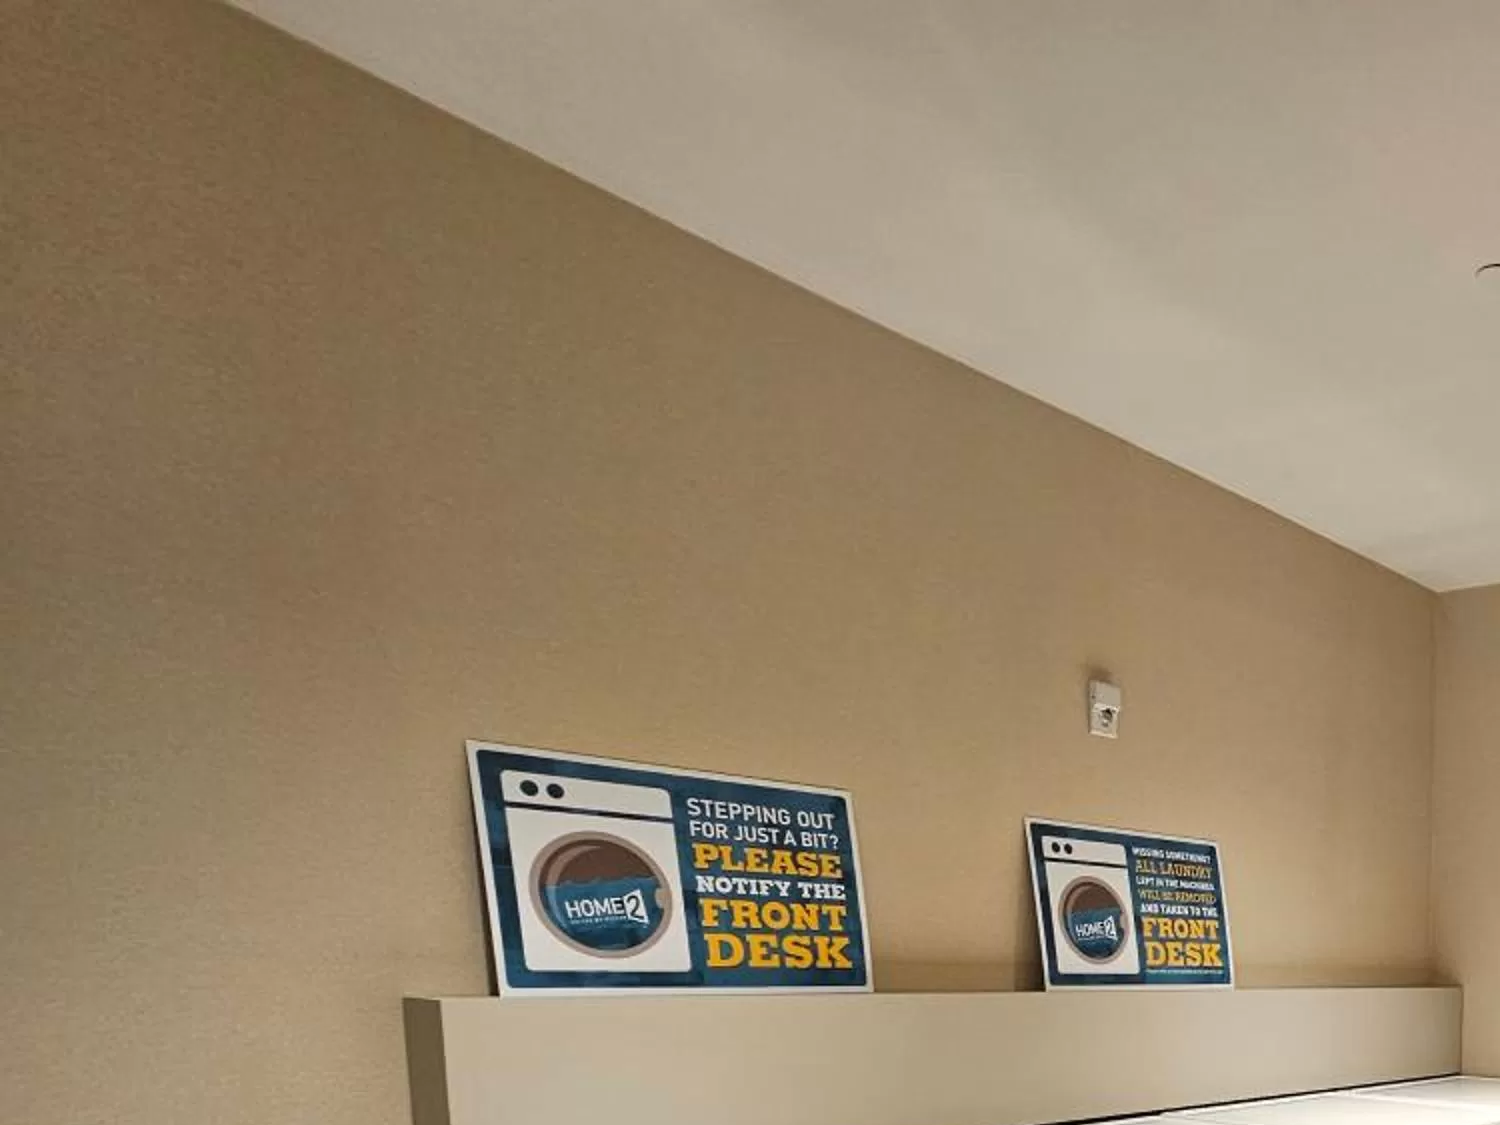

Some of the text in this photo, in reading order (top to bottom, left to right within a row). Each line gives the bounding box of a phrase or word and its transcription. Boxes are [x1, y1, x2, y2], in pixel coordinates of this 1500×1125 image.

[686, 797, 836, 830] STEPPING OUT
[689, 820, 839, 850] FOR JUST A BIT?
[692, 842, 843, 879] PLEASE
[1161, 863, 1212, 879] LAUNDRY
[695, 875, 846, 900] NOTIFY THE
[699, 898, 848, 931] FRONT
[1161, 904, 1189, 915] TAKEN
[1141, 915, 1219, 939] FRONT
[703, 932, 853, 969] DESK
[1144, 941, 1223, 967] DESK
